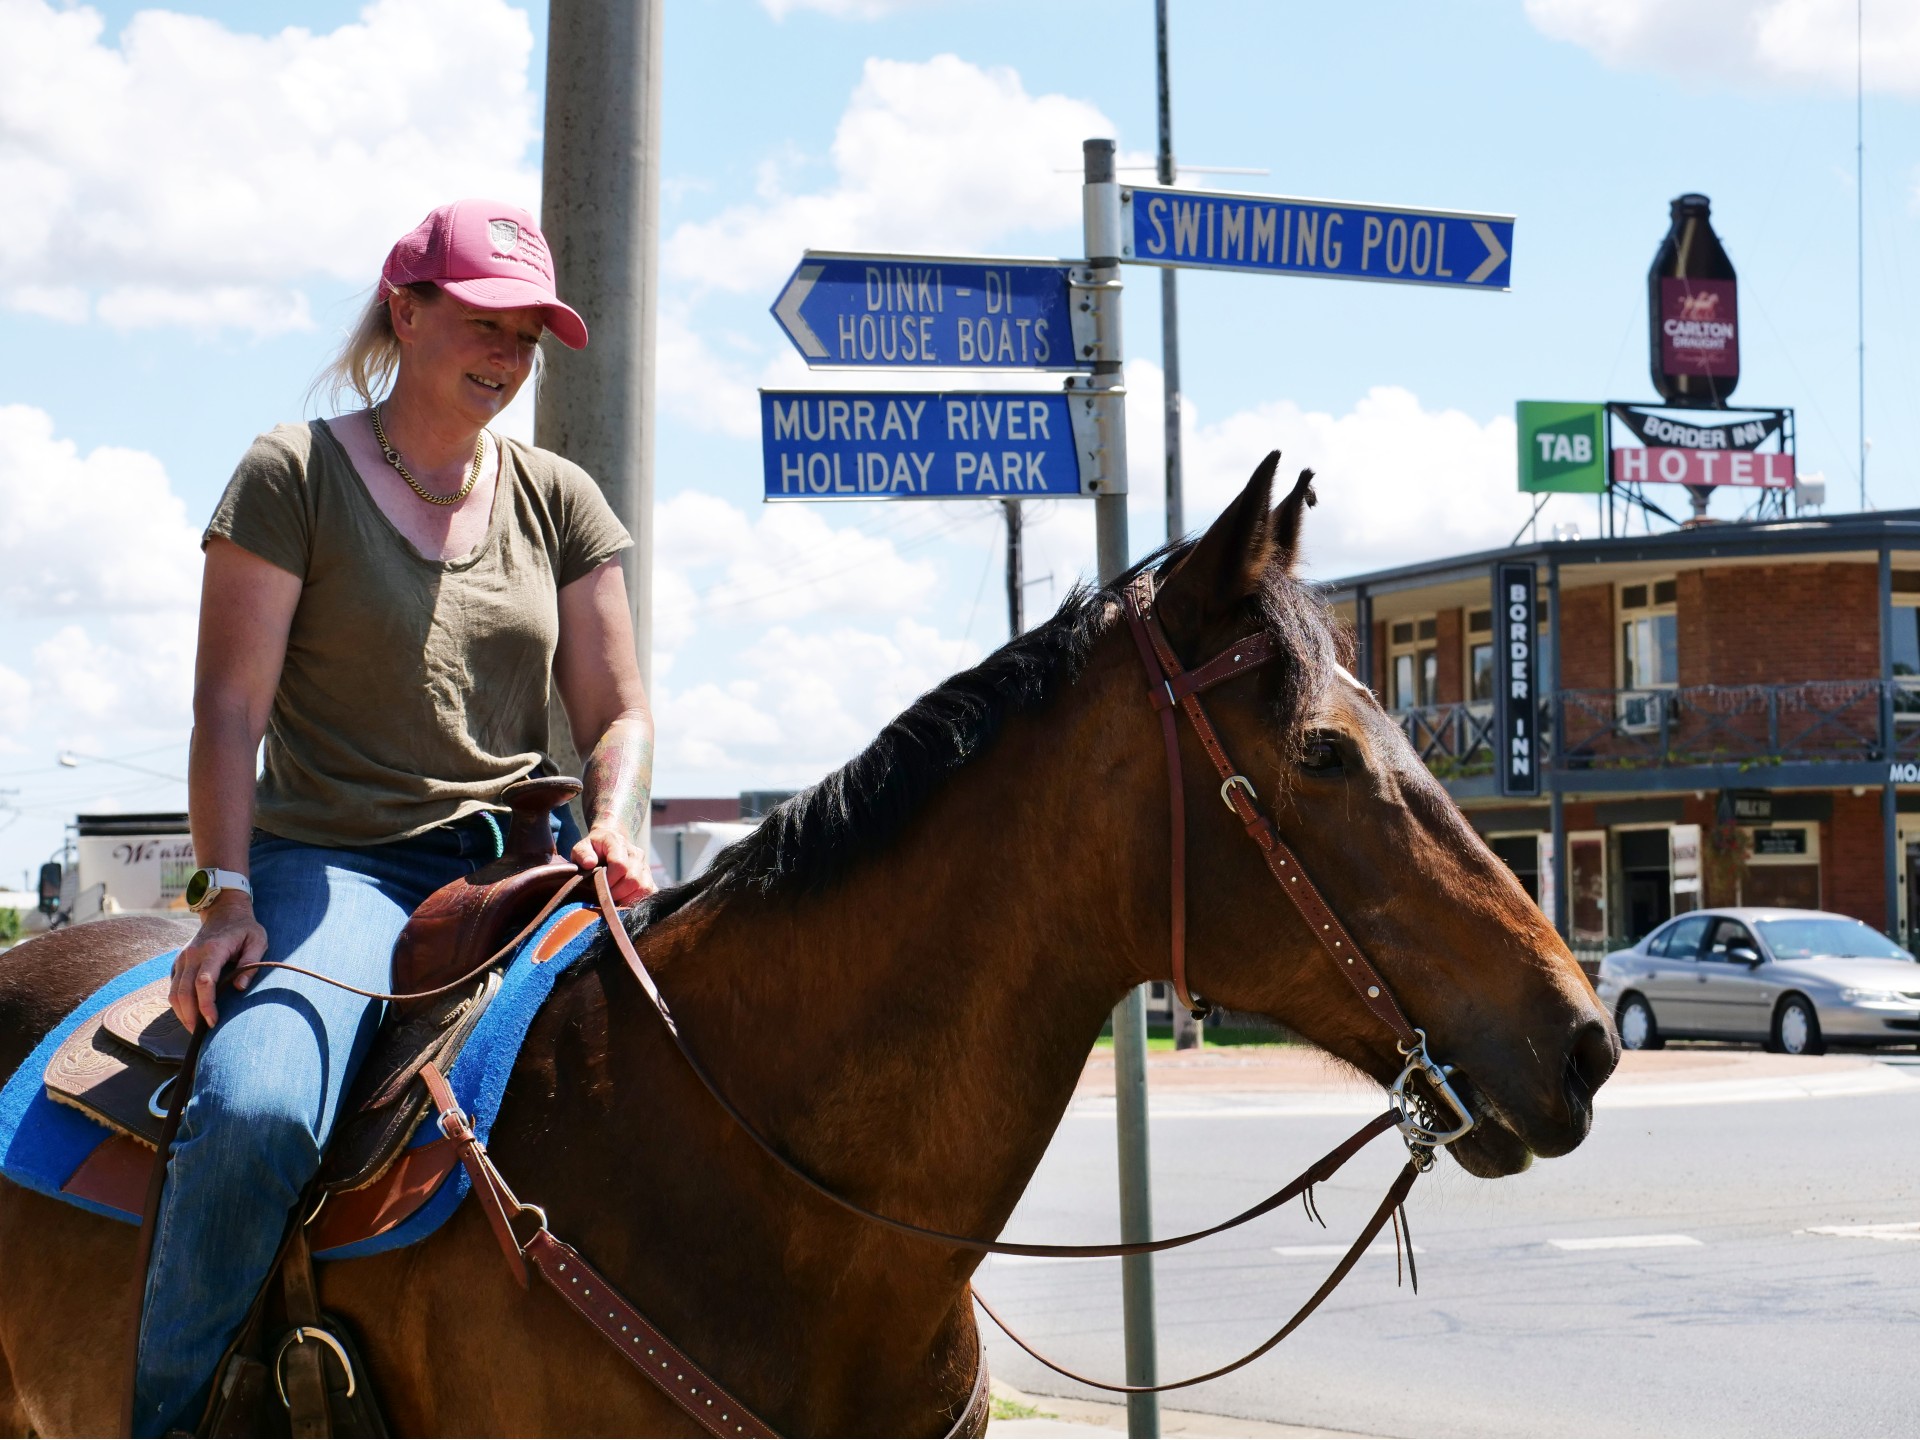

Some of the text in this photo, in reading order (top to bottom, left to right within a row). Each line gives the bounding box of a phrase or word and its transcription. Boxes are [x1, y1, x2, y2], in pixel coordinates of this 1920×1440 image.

[1147, 198, 1453, 277] SWIMMING POOL
[866, 267, 943, 312] DINKI
[985, 270, 1012, 314] DI
[838, 314, 1050, 362] HOUSE BOATS
[1664, 319, 1734, 339] CARLTON
[773, 400, 1050, 441] MURRAY RIVER
[1643, 416, 1766, 448] BORDER INN
[1536, 433, 1593, 463] TAB
[1622, 449, 1787, 486] HOTEL
[781, 452, 1048, 493] HOLIDAY PARK
[1509, 584, 1529, 775] BORDER INN
